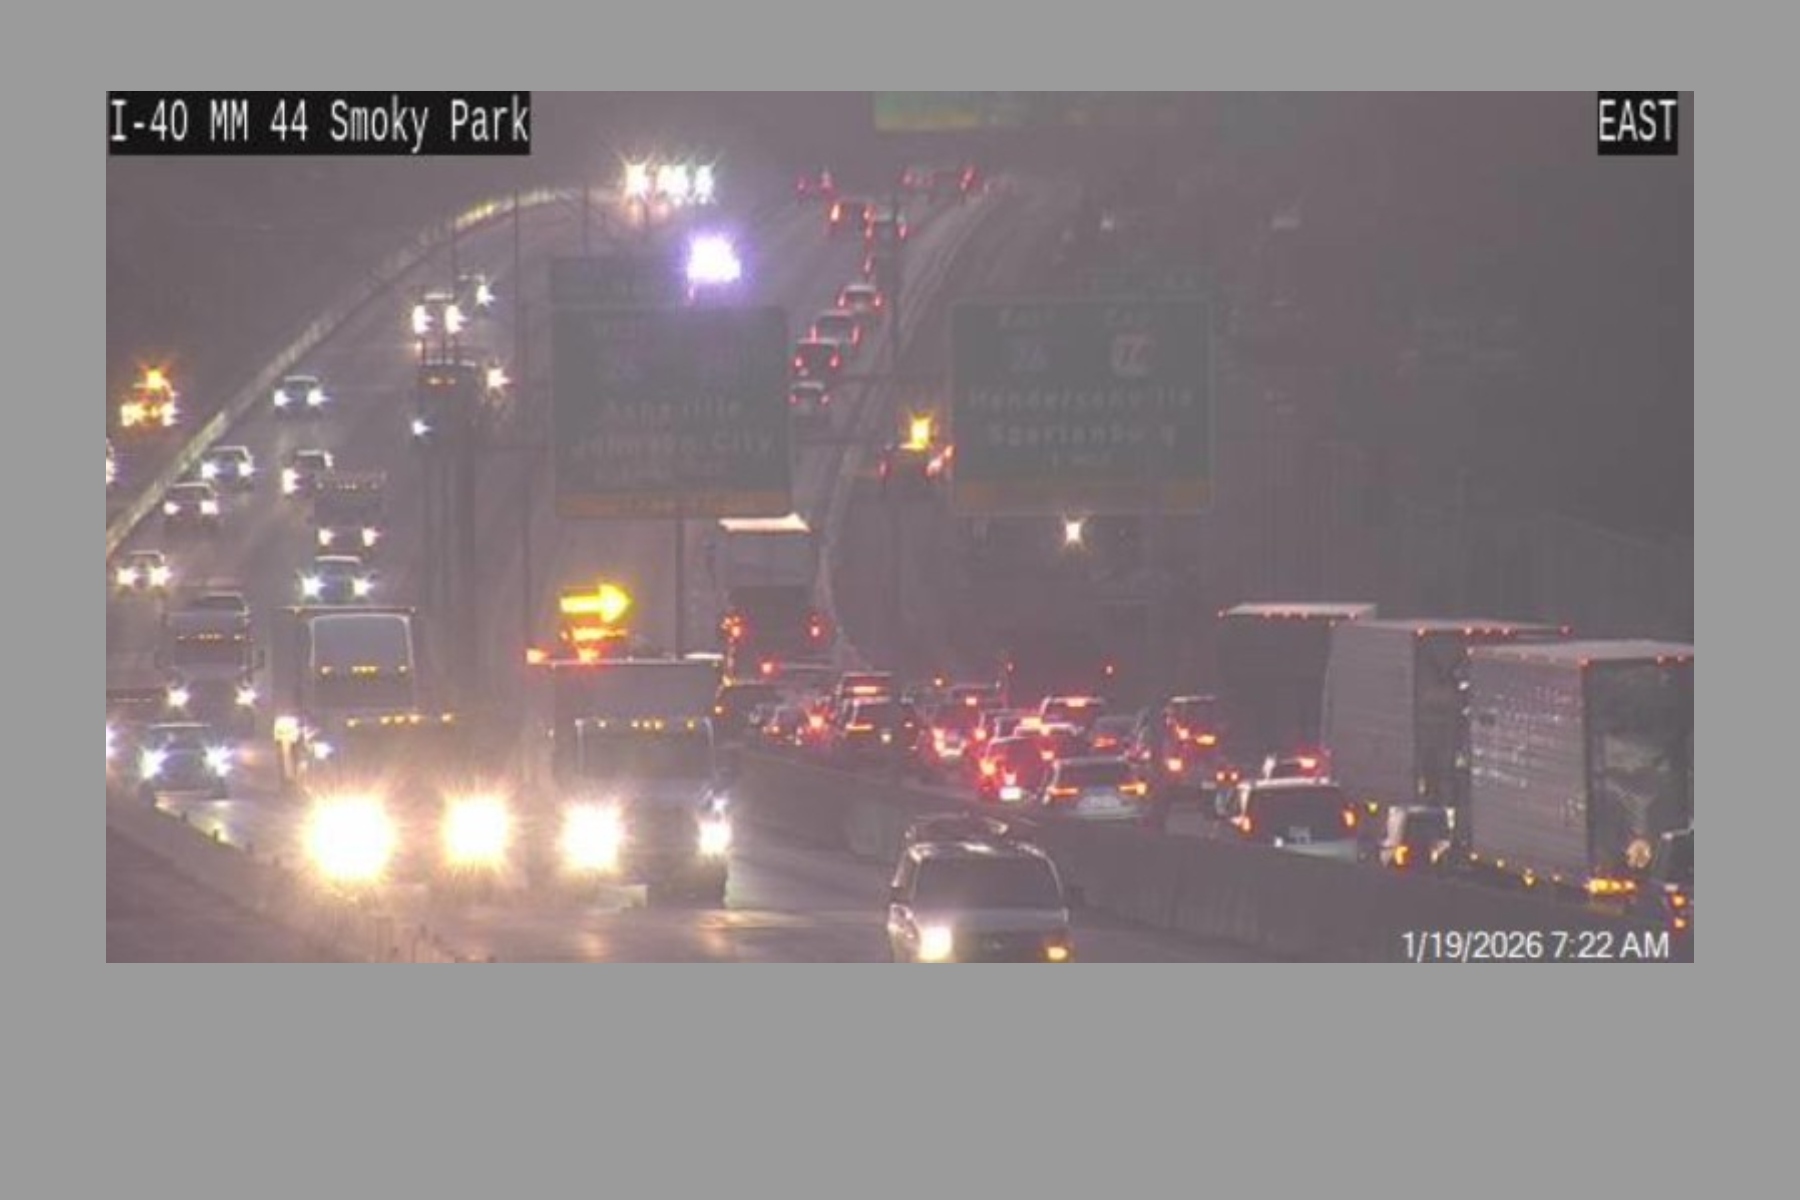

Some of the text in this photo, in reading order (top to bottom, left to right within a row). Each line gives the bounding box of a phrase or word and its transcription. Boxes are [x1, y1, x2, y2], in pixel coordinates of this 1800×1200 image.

[598, 396, 742, 426] Asheille
[967, 384, 1193, 413] Hendersonvlle
[988, 422, 1177, 450] Spartanbug
